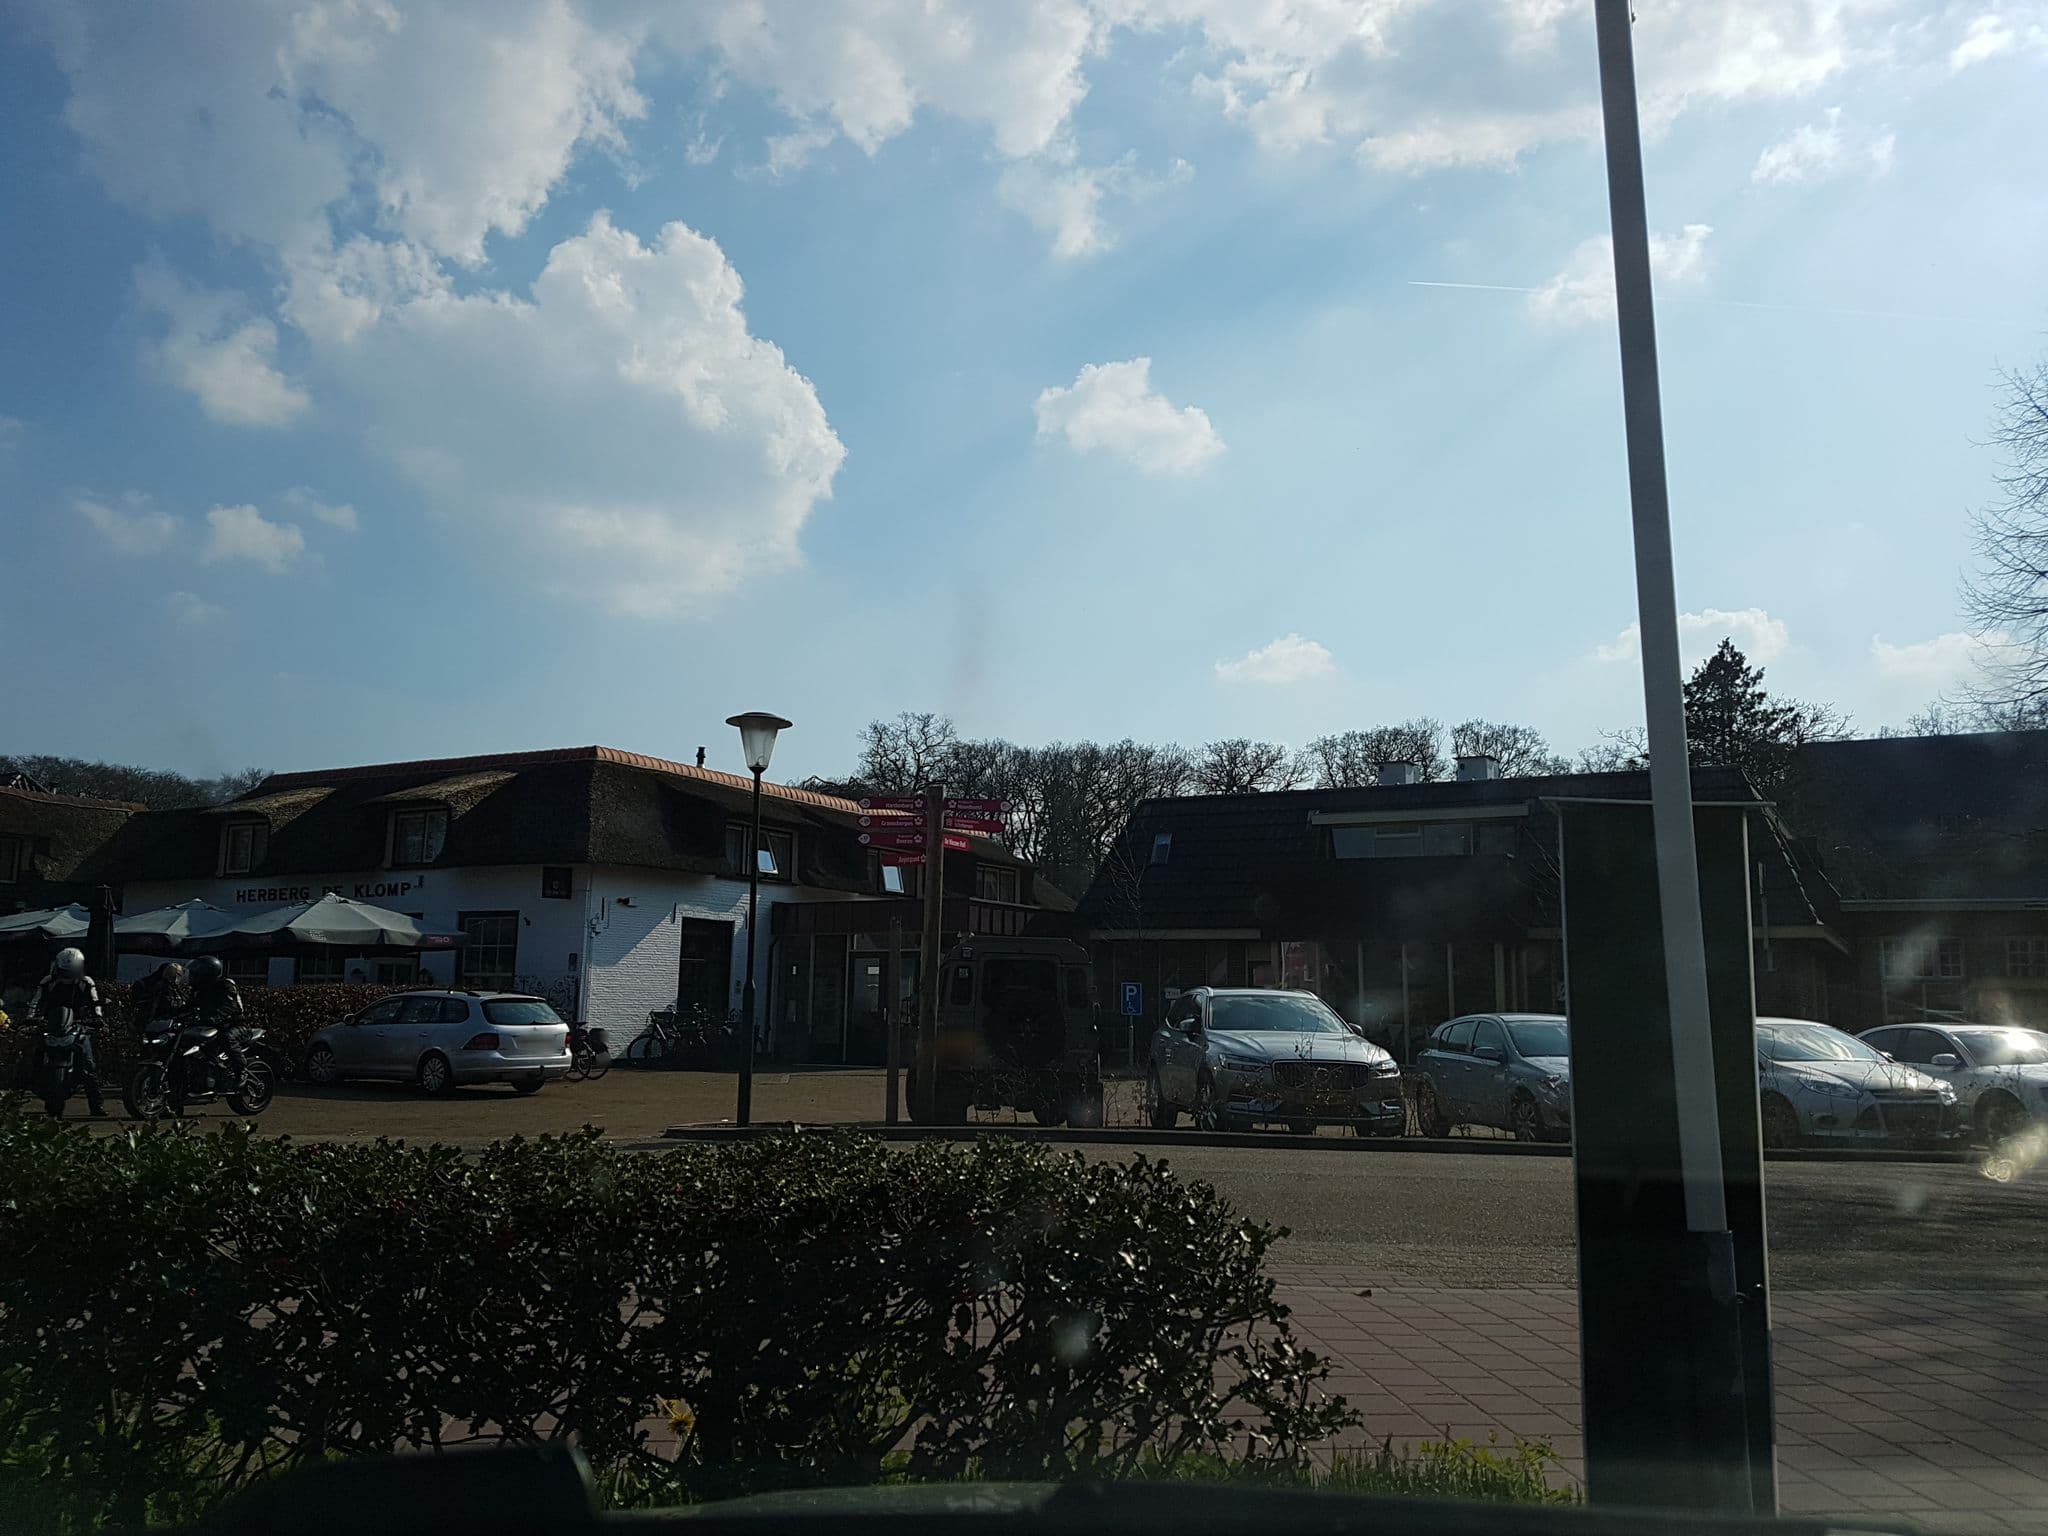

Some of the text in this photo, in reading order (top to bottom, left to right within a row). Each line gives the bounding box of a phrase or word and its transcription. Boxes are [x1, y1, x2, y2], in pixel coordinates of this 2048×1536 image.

[236, 881, 411, 903] HERBERG DE KLOMP
